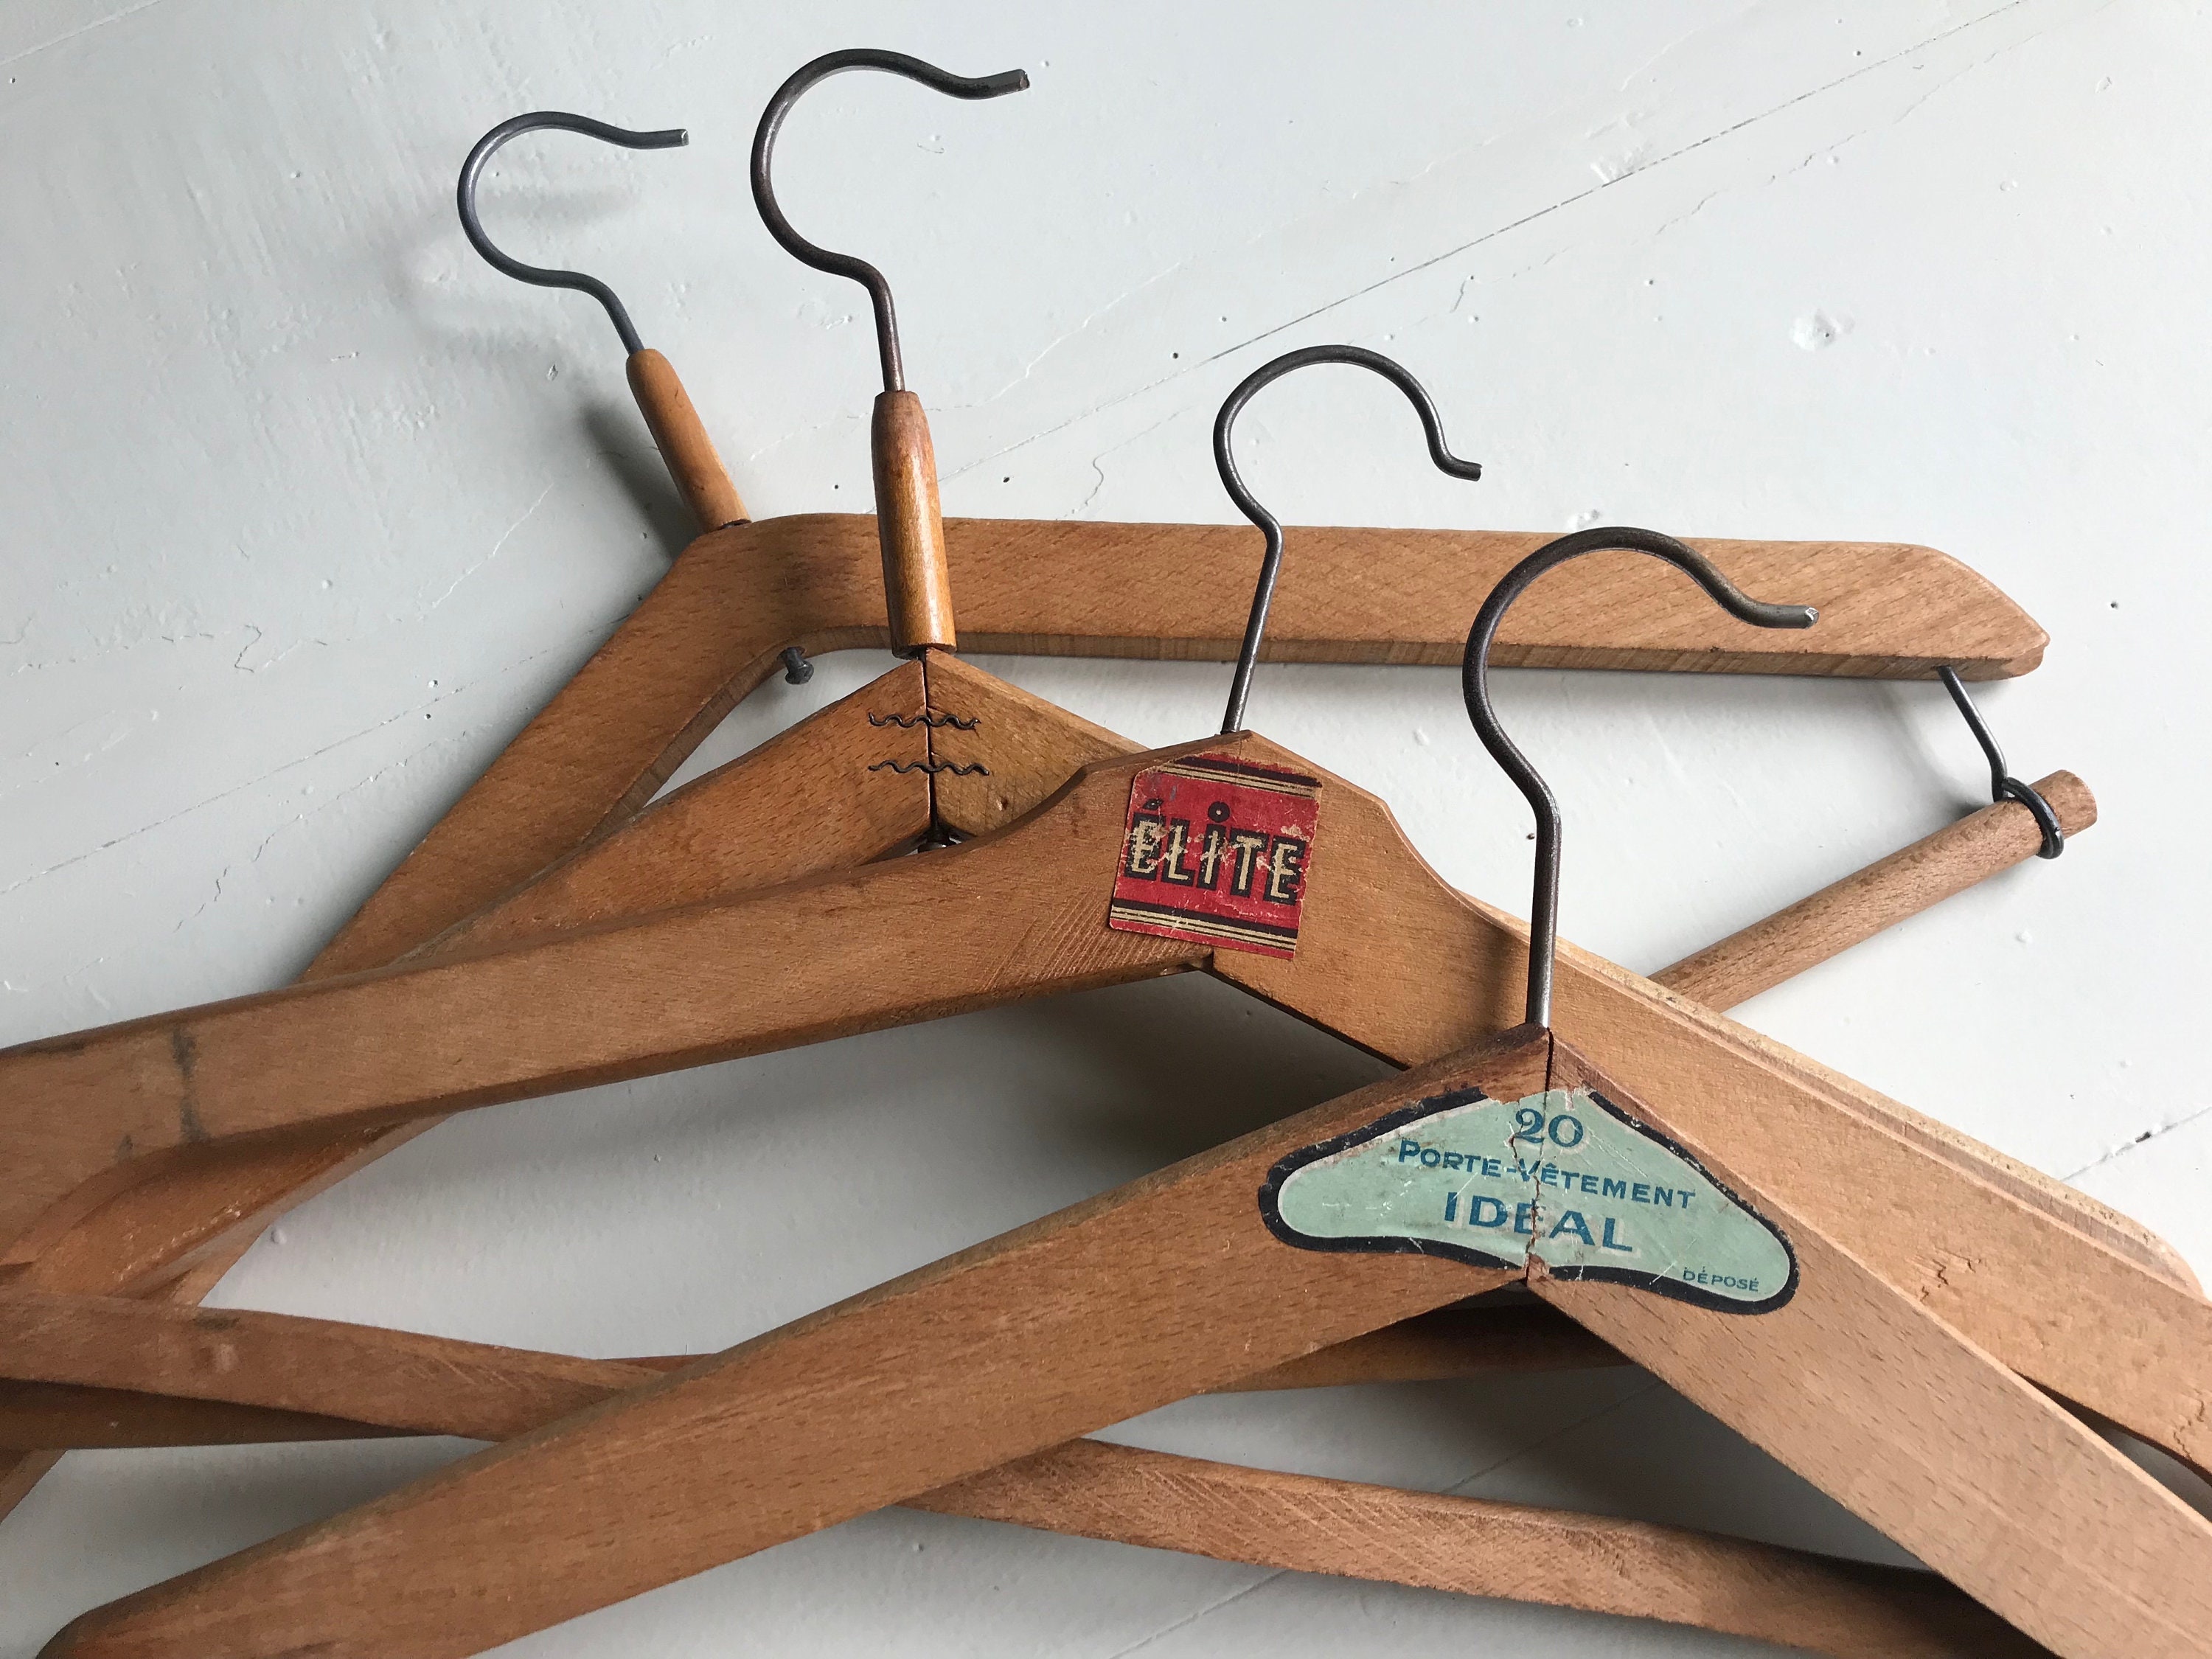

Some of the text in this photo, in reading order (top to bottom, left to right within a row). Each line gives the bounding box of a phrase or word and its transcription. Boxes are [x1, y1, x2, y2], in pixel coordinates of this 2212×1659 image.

[1514, 1107, 1584, 1147] 20
[1398, 1139, 1696, 1209] PORTE-VÊTEMENT
[1444, 1192, 1633, 1252] IDEAL
[1683, 1267, 1759, 1292] DÉPOSÉ
